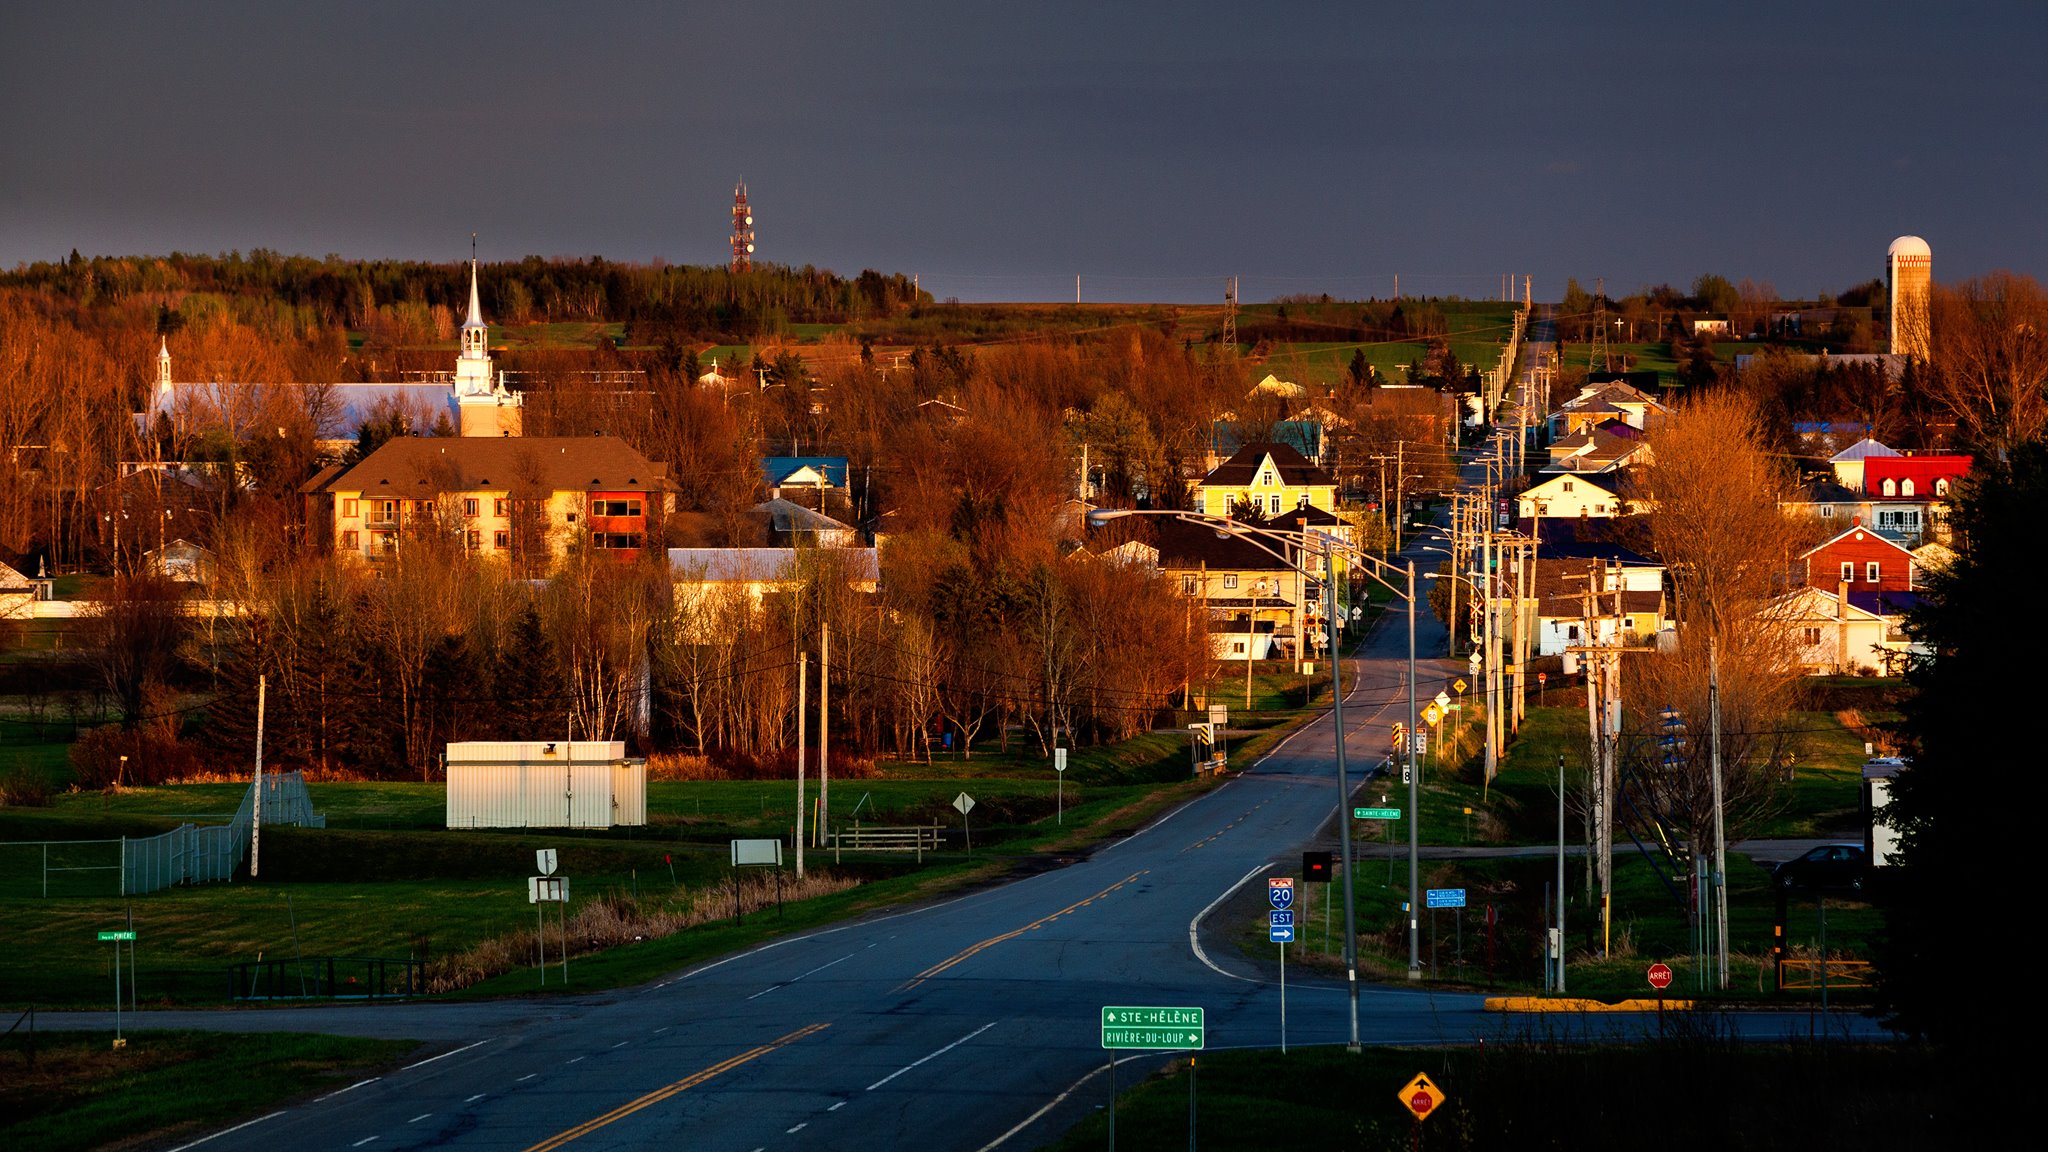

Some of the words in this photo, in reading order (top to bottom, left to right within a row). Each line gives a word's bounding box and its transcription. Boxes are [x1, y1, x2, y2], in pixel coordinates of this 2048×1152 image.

[1273, 889, 1290, 901] 20
[1272, 913, 1290, 923] EST
[1649, 970, 1671, 980] ARRÊT
[1120, 1010, 1198, 1023] STE-HÉLÈNE
[1106, 1030, 1184, 1043] RIVIÈRE-DU-LOUP
